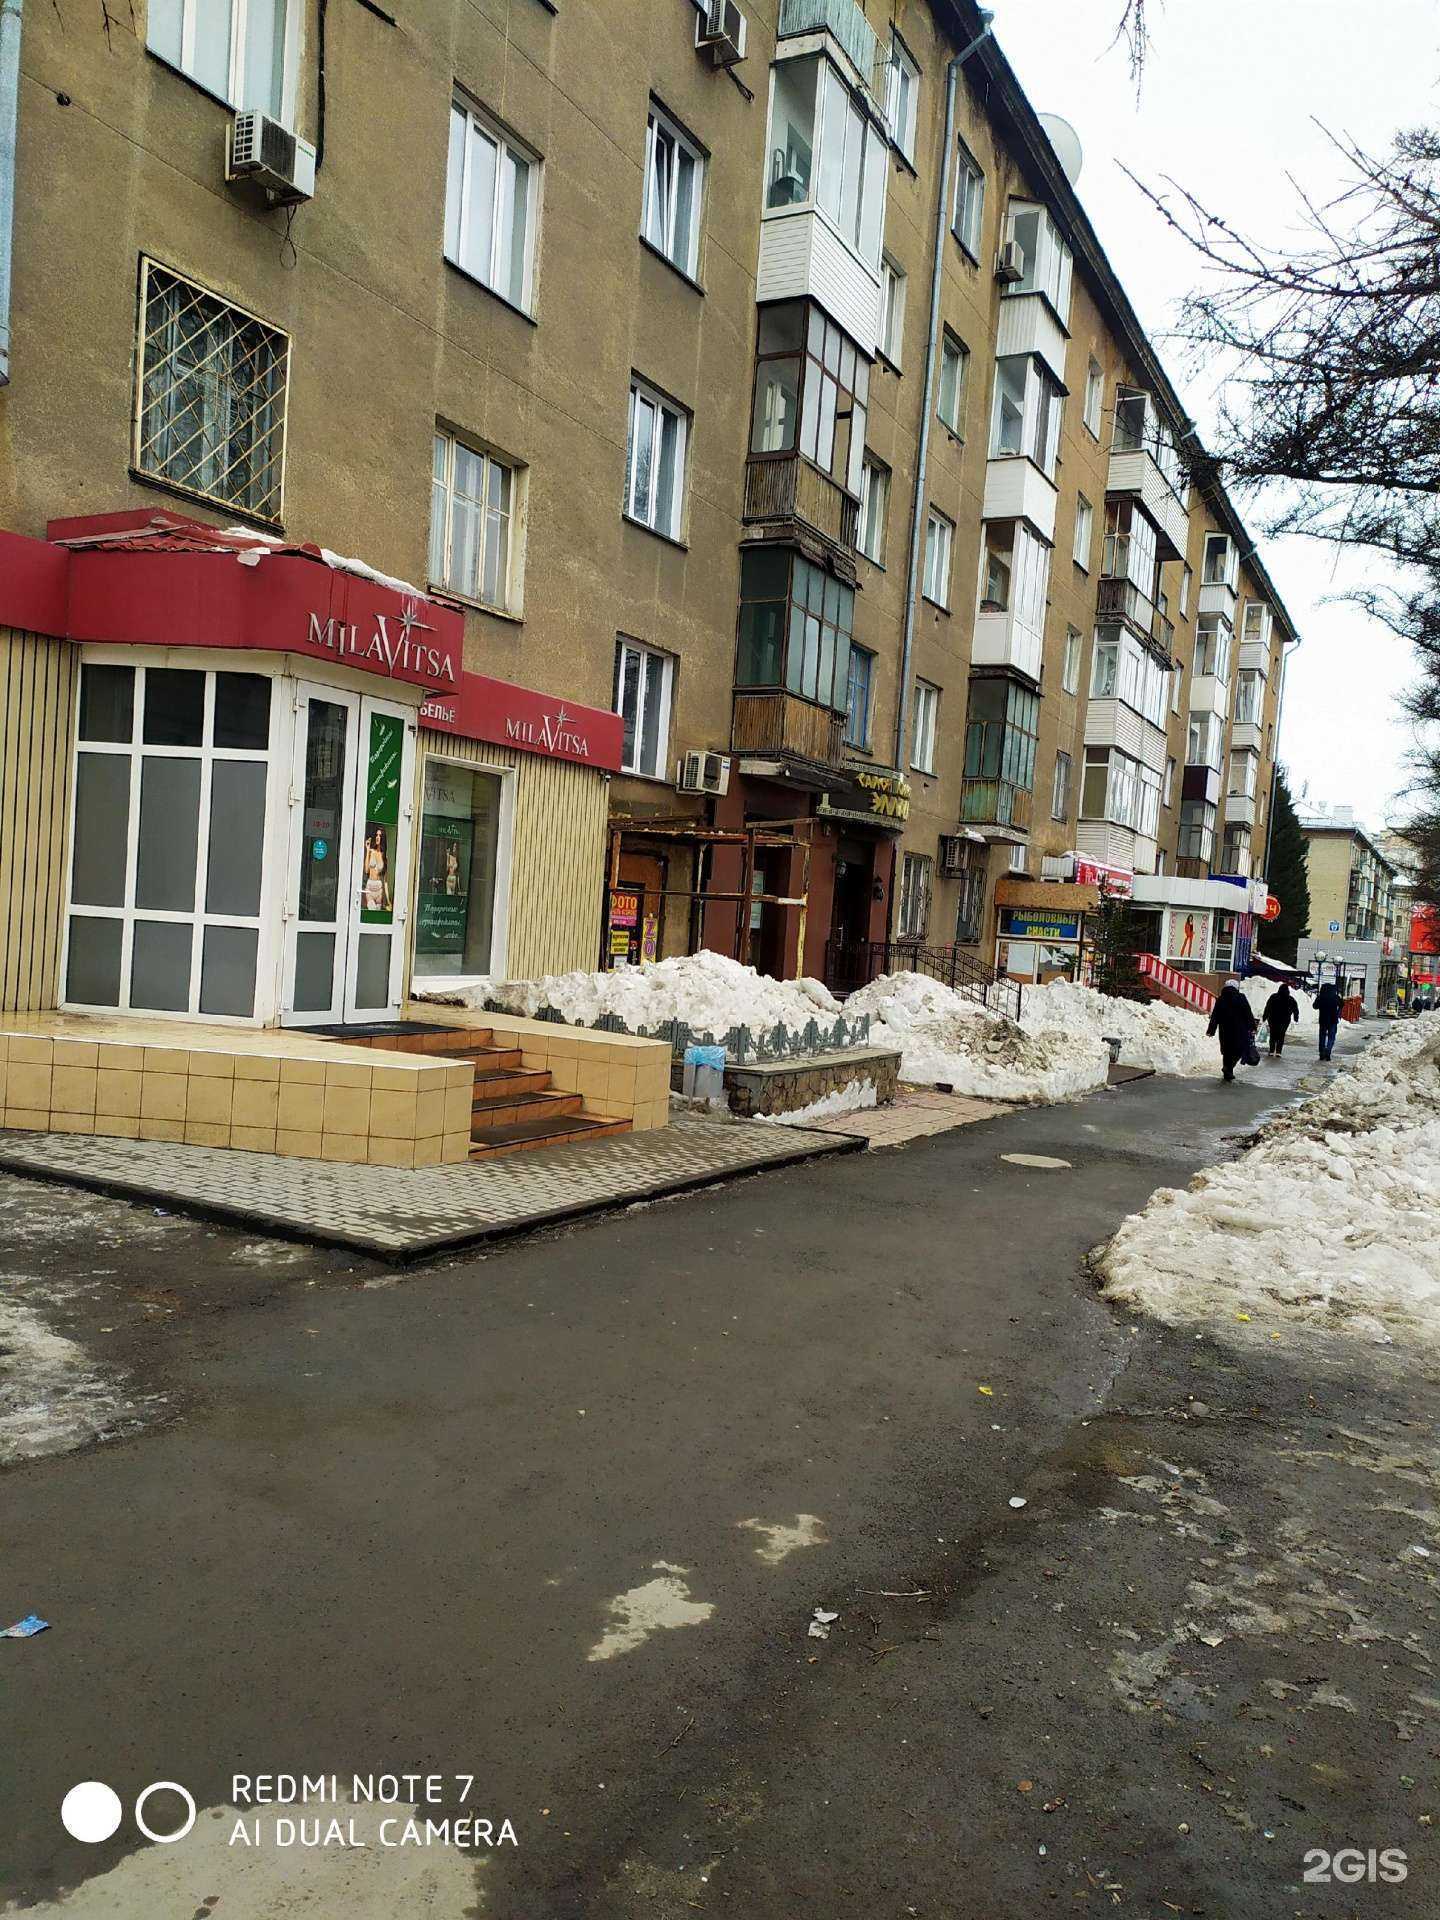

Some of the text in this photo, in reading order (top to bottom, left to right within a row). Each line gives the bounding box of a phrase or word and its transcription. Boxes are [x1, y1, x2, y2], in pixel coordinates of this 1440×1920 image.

[306, 612, 455, 682] MILAVITSA
[505, 714, 589, 757] MILAVITSA
[1013, 910, 1077, 925] РЫБОЛОВНЫЕ
[1026, 926, 1060, 938] СНАСТИ
